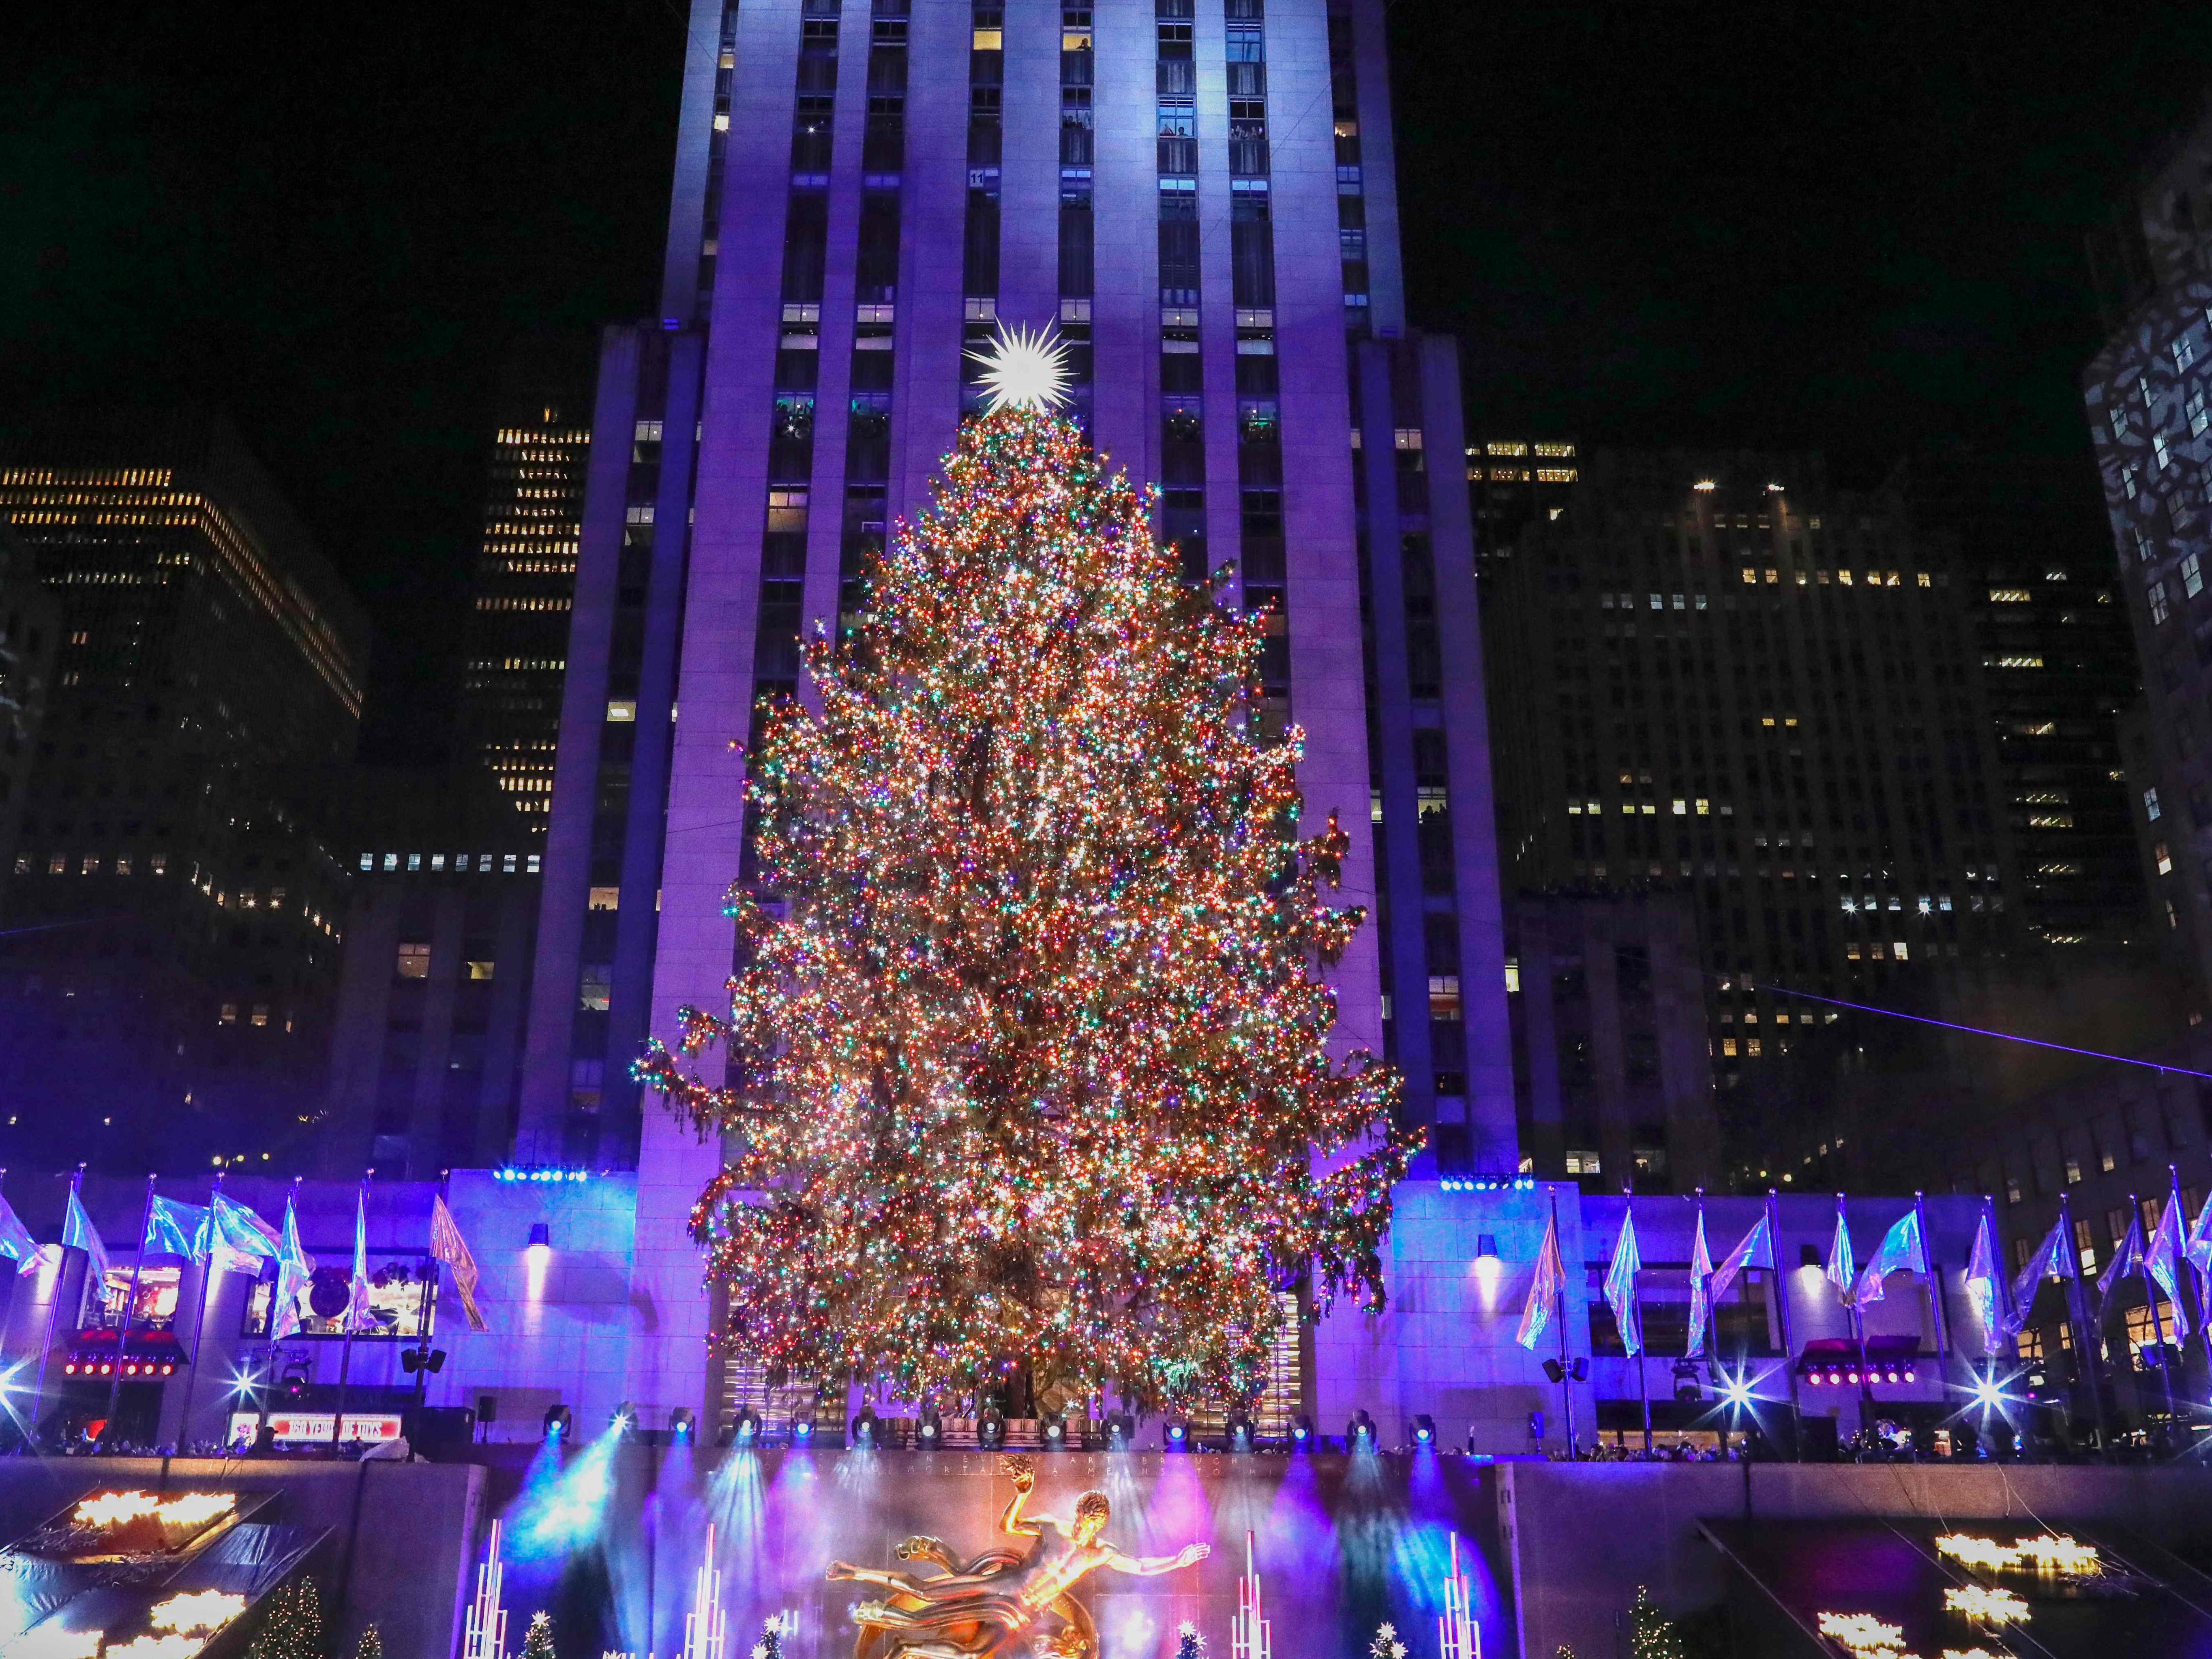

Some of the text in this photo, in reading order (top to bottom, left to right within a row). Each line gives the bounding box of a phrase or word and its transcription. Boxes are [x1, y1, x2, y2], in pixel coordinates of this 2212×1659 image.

[971, 173, 982, 183] 11
[289, 1420, 382, 1437] 160 YEAR OF TOYS
[907, 1465, 1005, 1475] MORTAL
